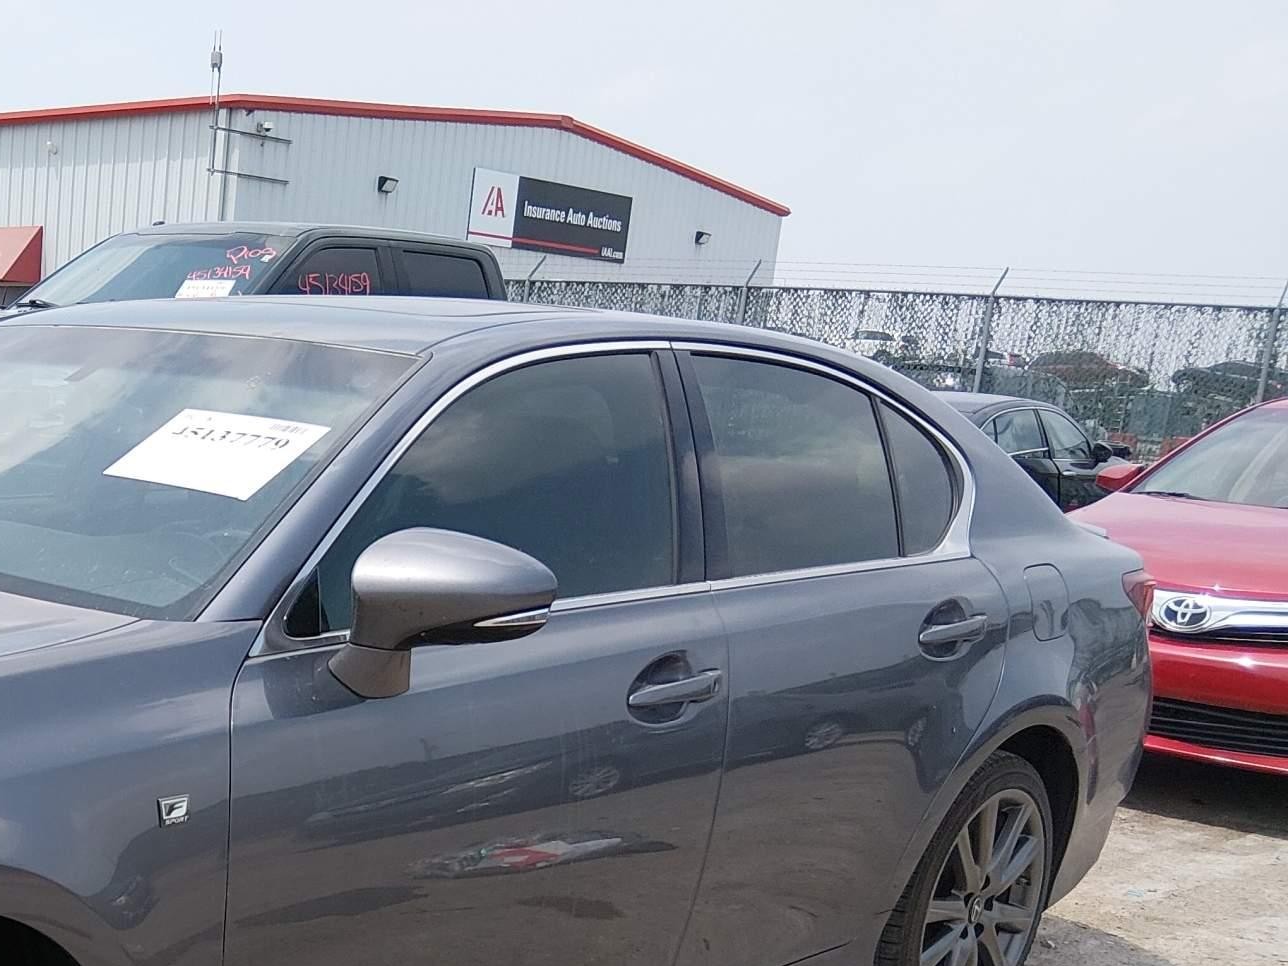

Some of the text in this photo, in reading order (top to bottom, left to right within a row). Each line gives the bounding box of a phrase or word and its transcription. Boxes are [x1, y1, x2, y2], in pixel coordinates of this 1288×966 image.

[523, 200, 622, 233] Insurance Auto Auctions
[187, 264, 251, 280] 45134159
[298, 272, 371, 296] 45134159
